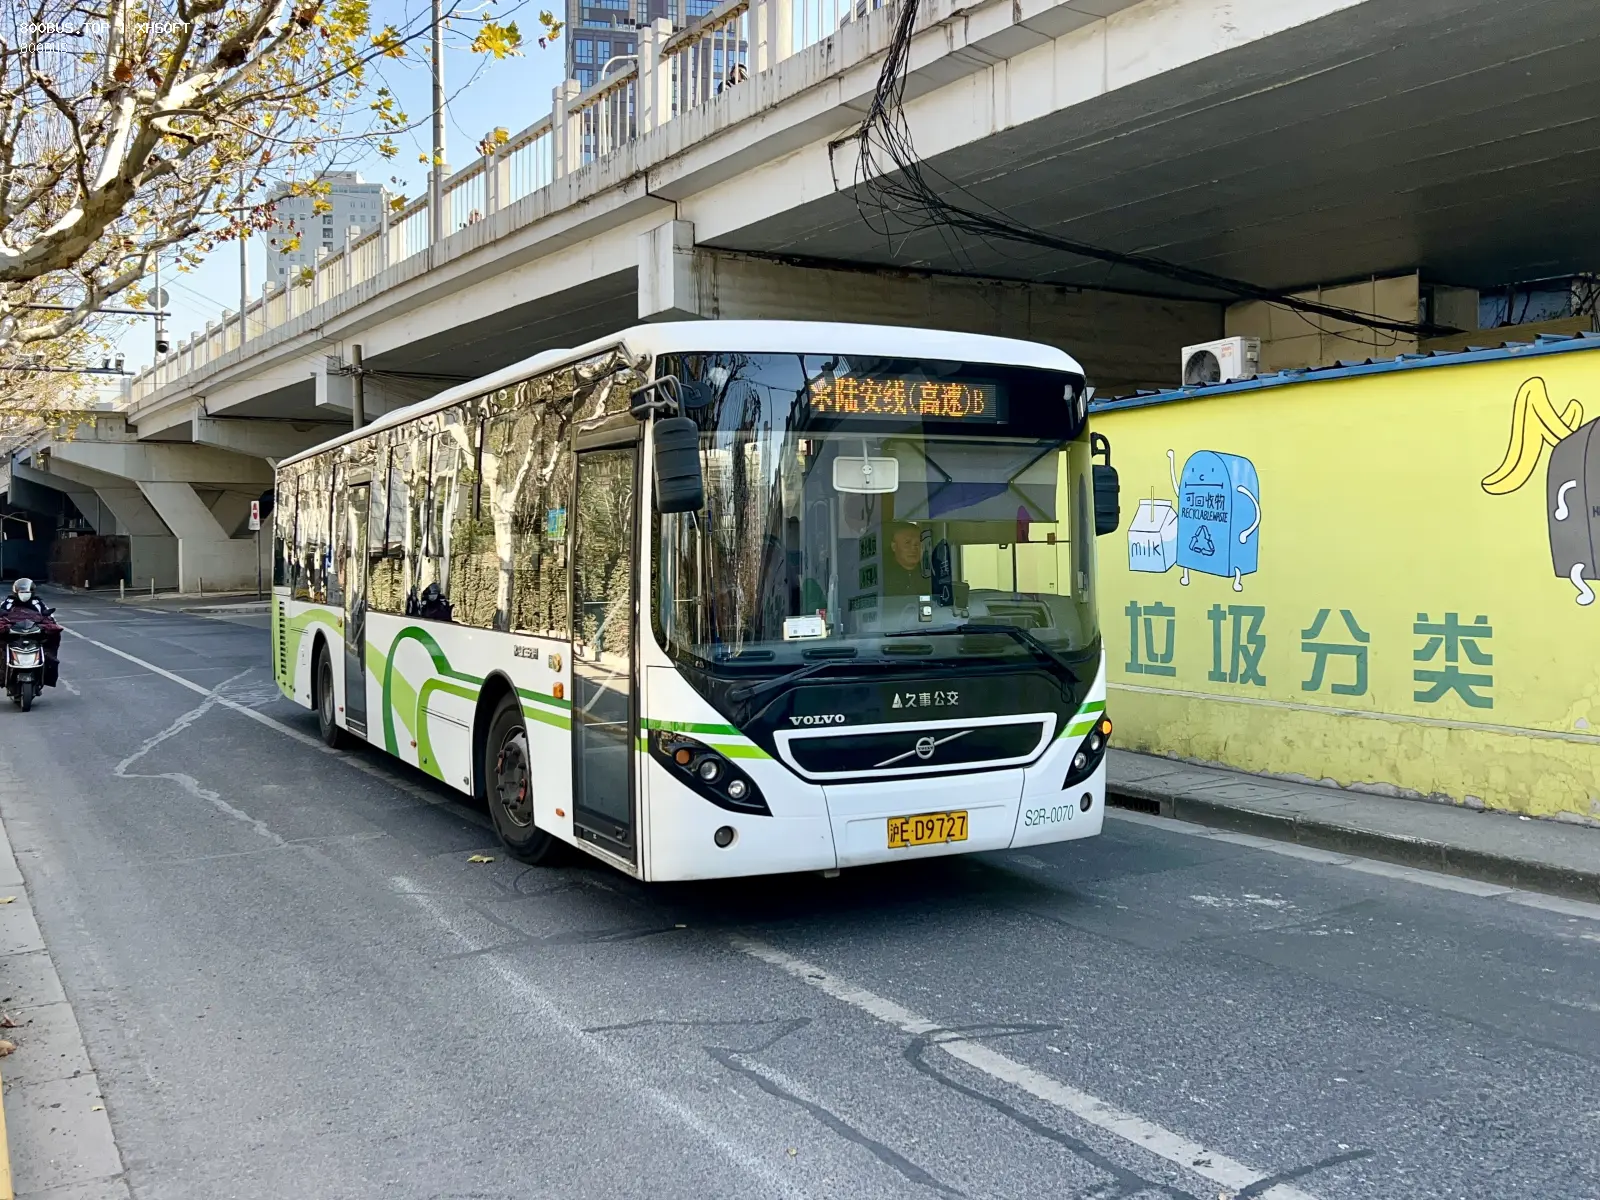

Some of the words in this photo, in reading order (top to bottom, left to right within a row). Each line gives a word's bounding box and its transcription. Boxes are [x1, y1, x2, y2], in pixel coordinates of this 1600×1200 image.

[1185, 491, 1225, 511] 可回收物
[1131, 539, 1161, 557] milk
[1125, 601, 1494, 709] 垃圾分类
[905, 690, 959, 708] 久事公交
[789, 713, 846, 726] VOLVO
[1024, 804, 1075, 827] S2R-0070
